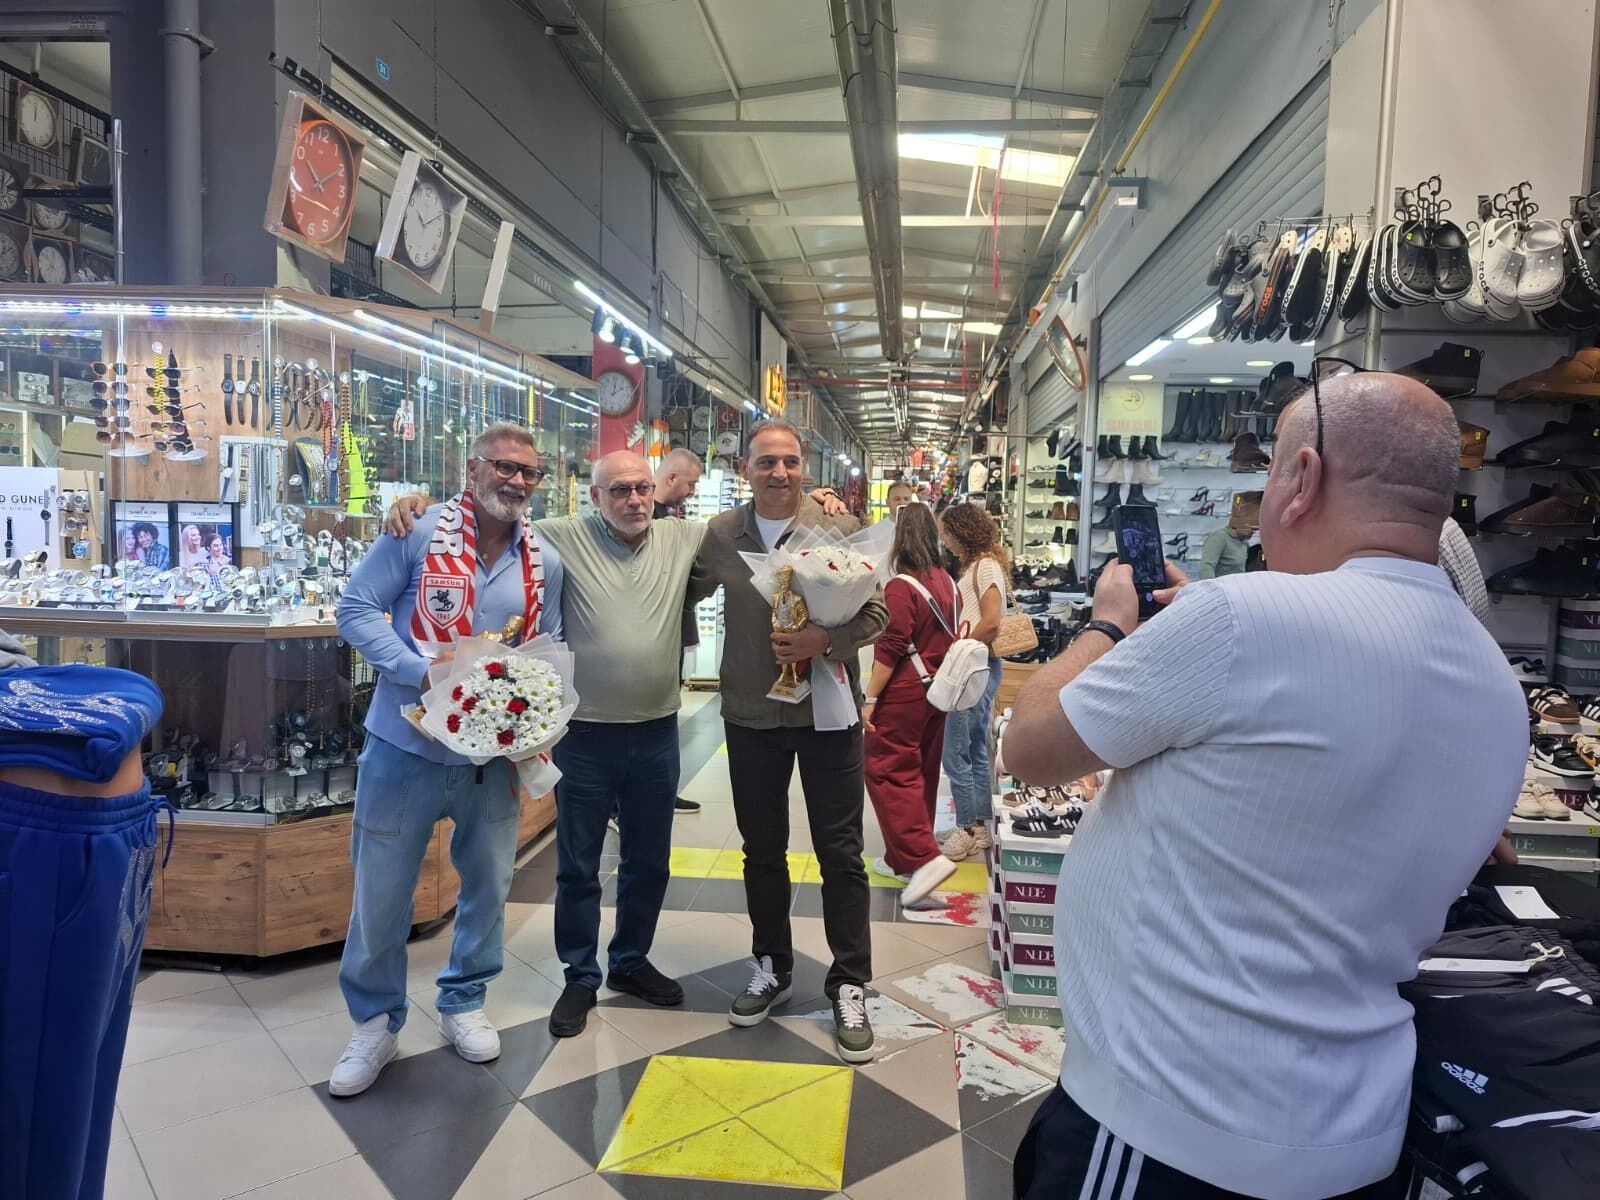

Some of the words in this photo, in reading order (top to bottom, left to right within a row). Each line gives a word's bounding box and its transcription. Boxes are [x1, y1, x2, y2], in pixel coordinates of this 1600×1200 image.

[304, 133, 314, 146] 11
[318, 127, 330, 144] 12
[333, 144, 338, 157] 1
[337, 163, 345, 177] 2
[338, 185, 345, 199] 3
[296, 212, 304, 224] 7
[332, 205, 340, 218] 4
[307, 223, 316, 236] 6
[321, 219, 329, 233] 5
[1479, 260, 1490, 292] crocs
[1578, 258, 1598, 291] crocs
[1339, 275, 1356, 306] crocs
[1320, 284, 1334, 315] crocs
[11, 494, 50, 504] GUNE
[1441, 1061, 1485, 1095] adidas
